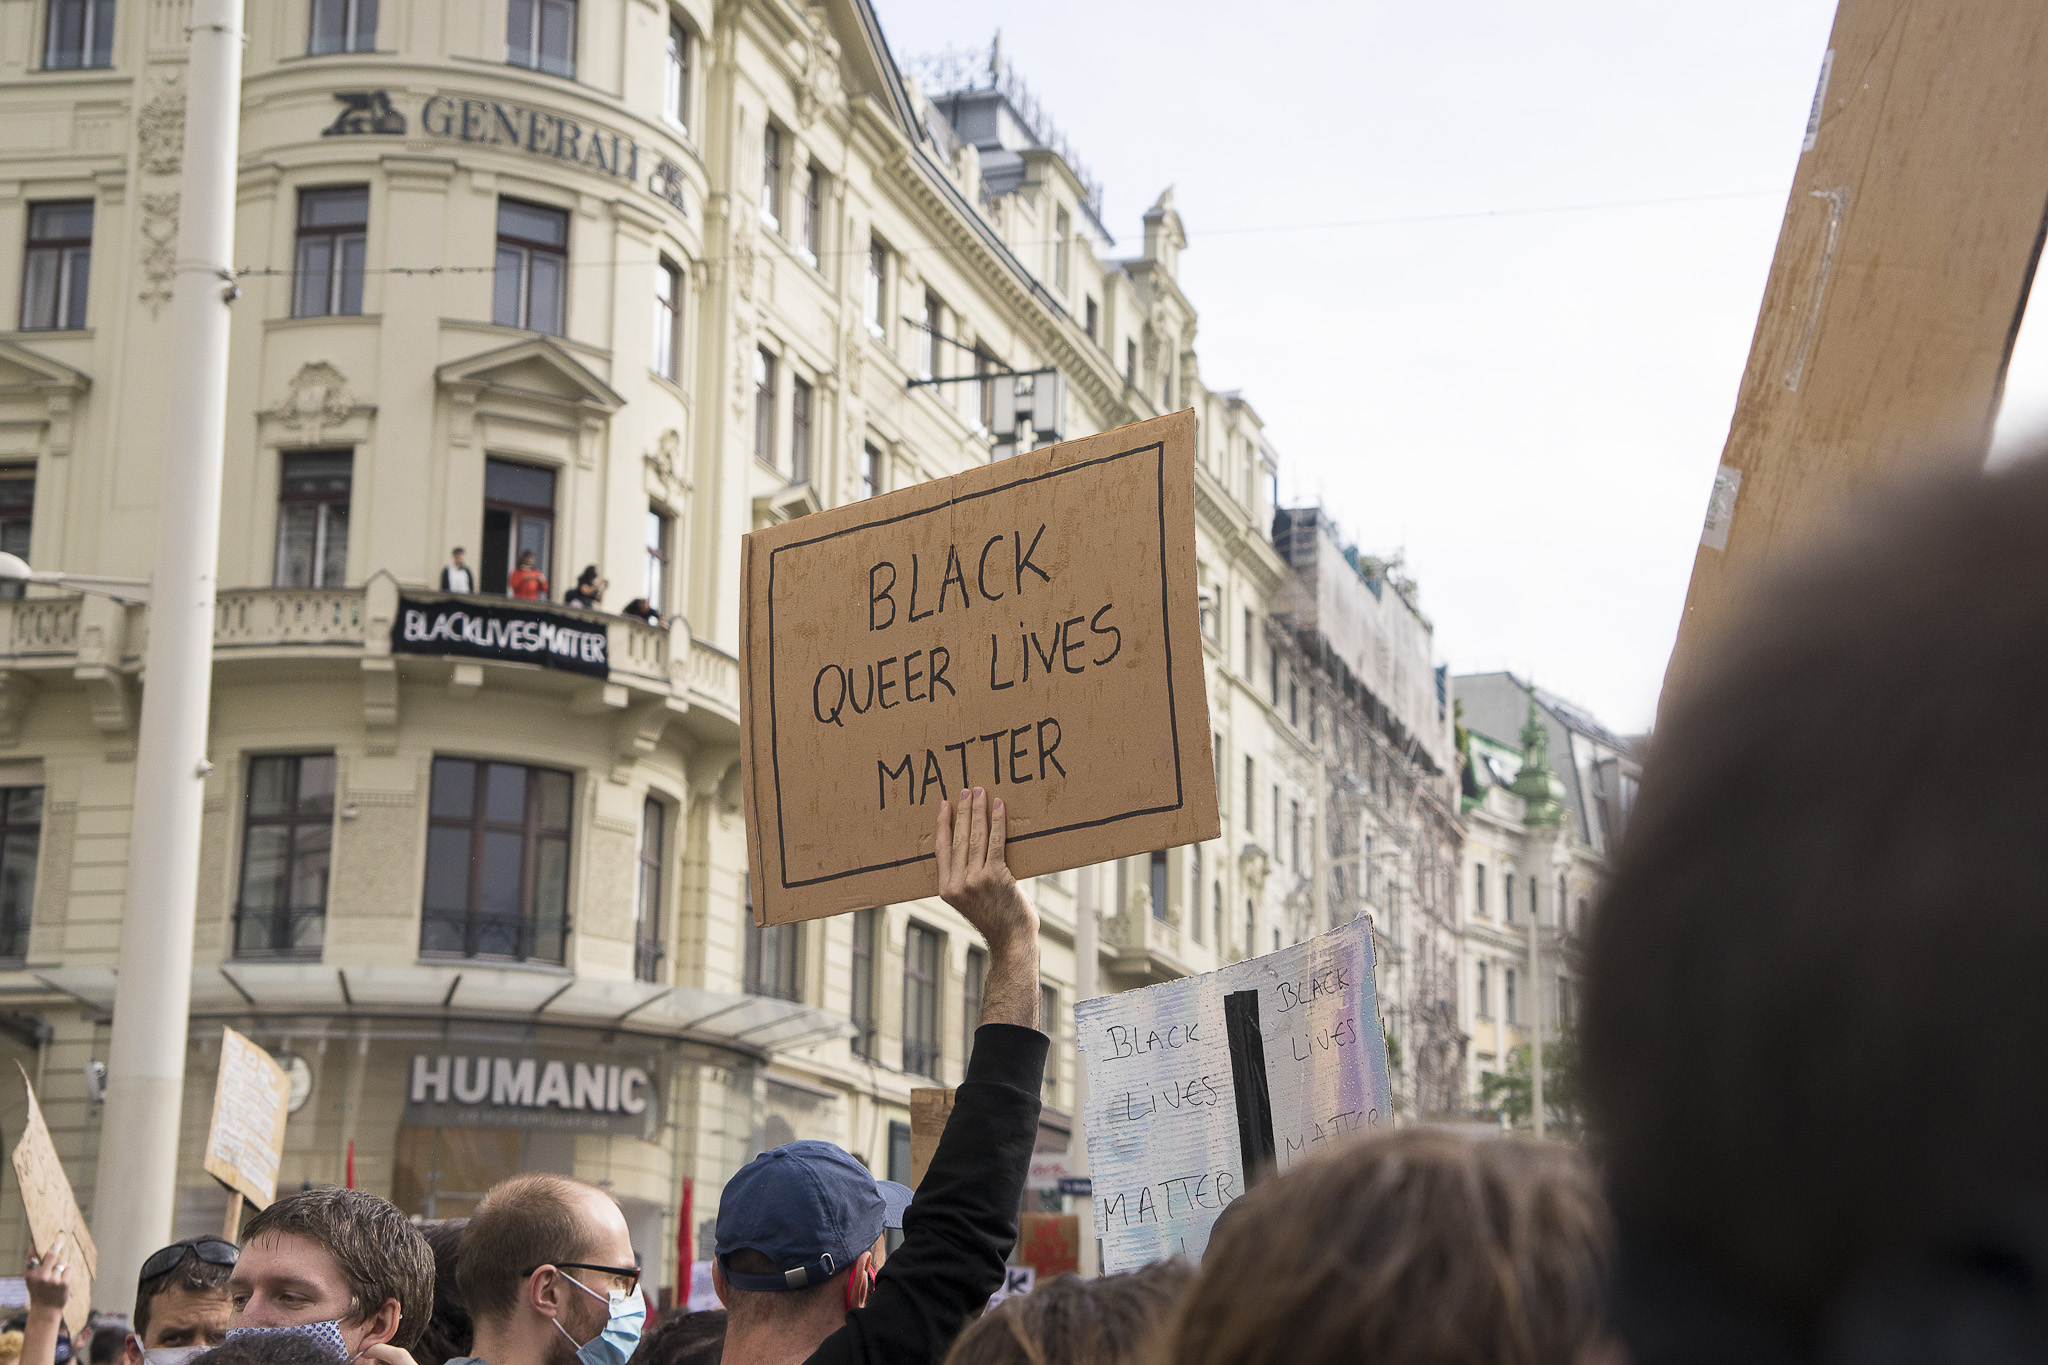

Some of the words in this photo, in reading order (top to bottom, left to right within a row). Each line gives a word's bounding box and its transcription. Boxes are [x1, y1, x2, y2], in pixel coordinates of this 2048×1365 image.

[421, 95, 640, 182] GENERALI
[869, 523, 1051, 632] BLACK
[812, 646, 956, 728] QUEER
[877, 717, 1067, 811] MATTER
[1276, 967, 1350, 1013] BLACK
[1102, 1022, 1202, 1062] BLACK
[411, 1054, 649, 1115] HUMANIC
[1103, 1171, 1238, 1232] MATTER
